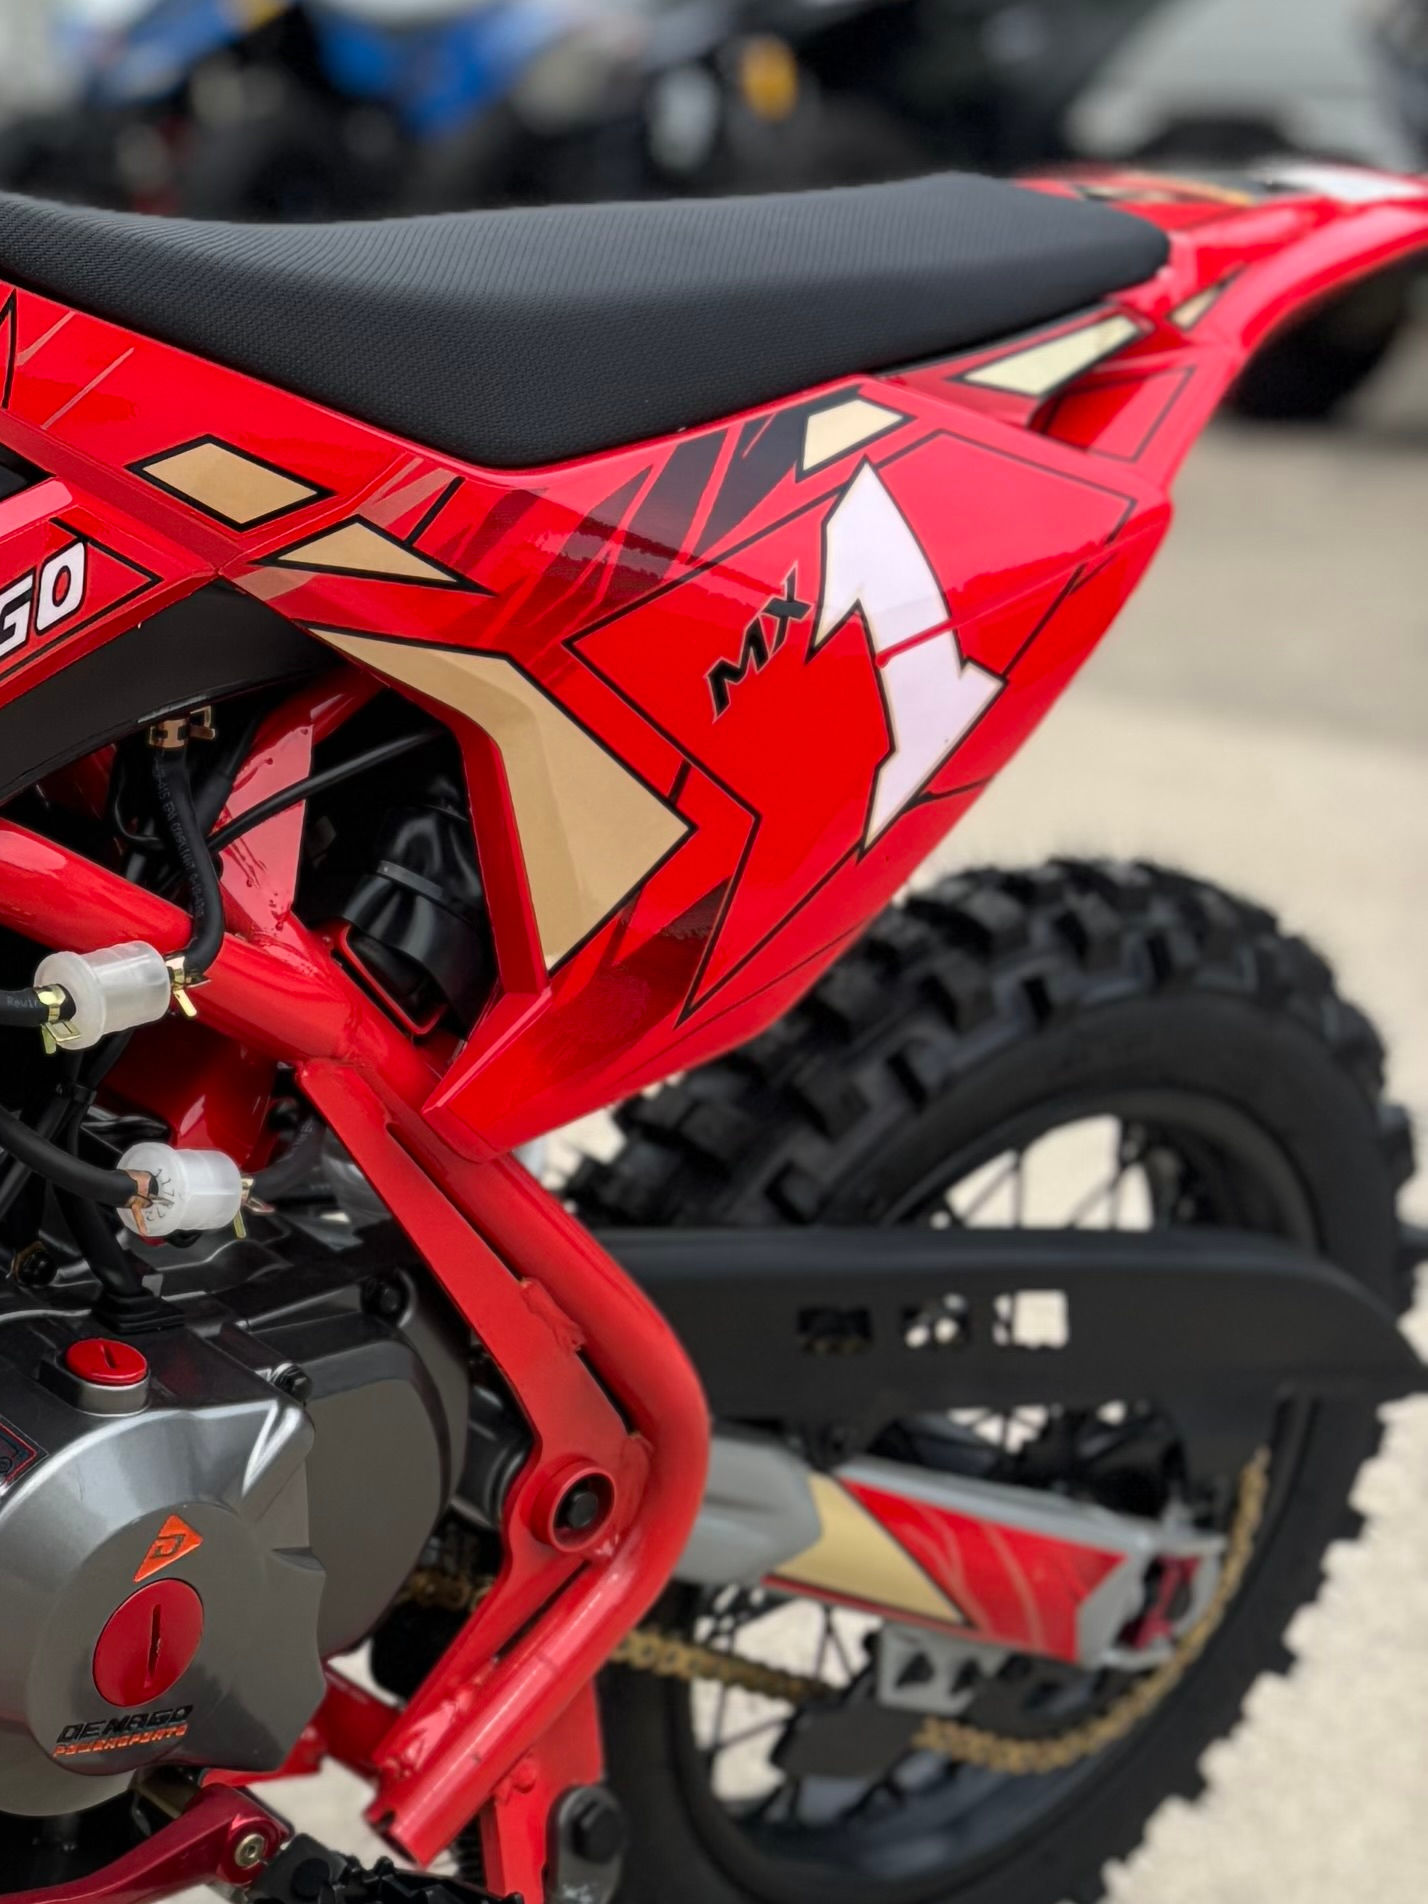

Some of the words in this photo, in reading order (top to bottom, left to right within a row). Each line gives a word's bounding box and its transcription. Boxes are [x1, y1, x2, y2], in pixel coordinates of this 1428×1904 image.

[706, 561, 812, 724] MX
[805, 457, 1009, 863] 1
[56, 1705, 193, 1743] DENAGO
